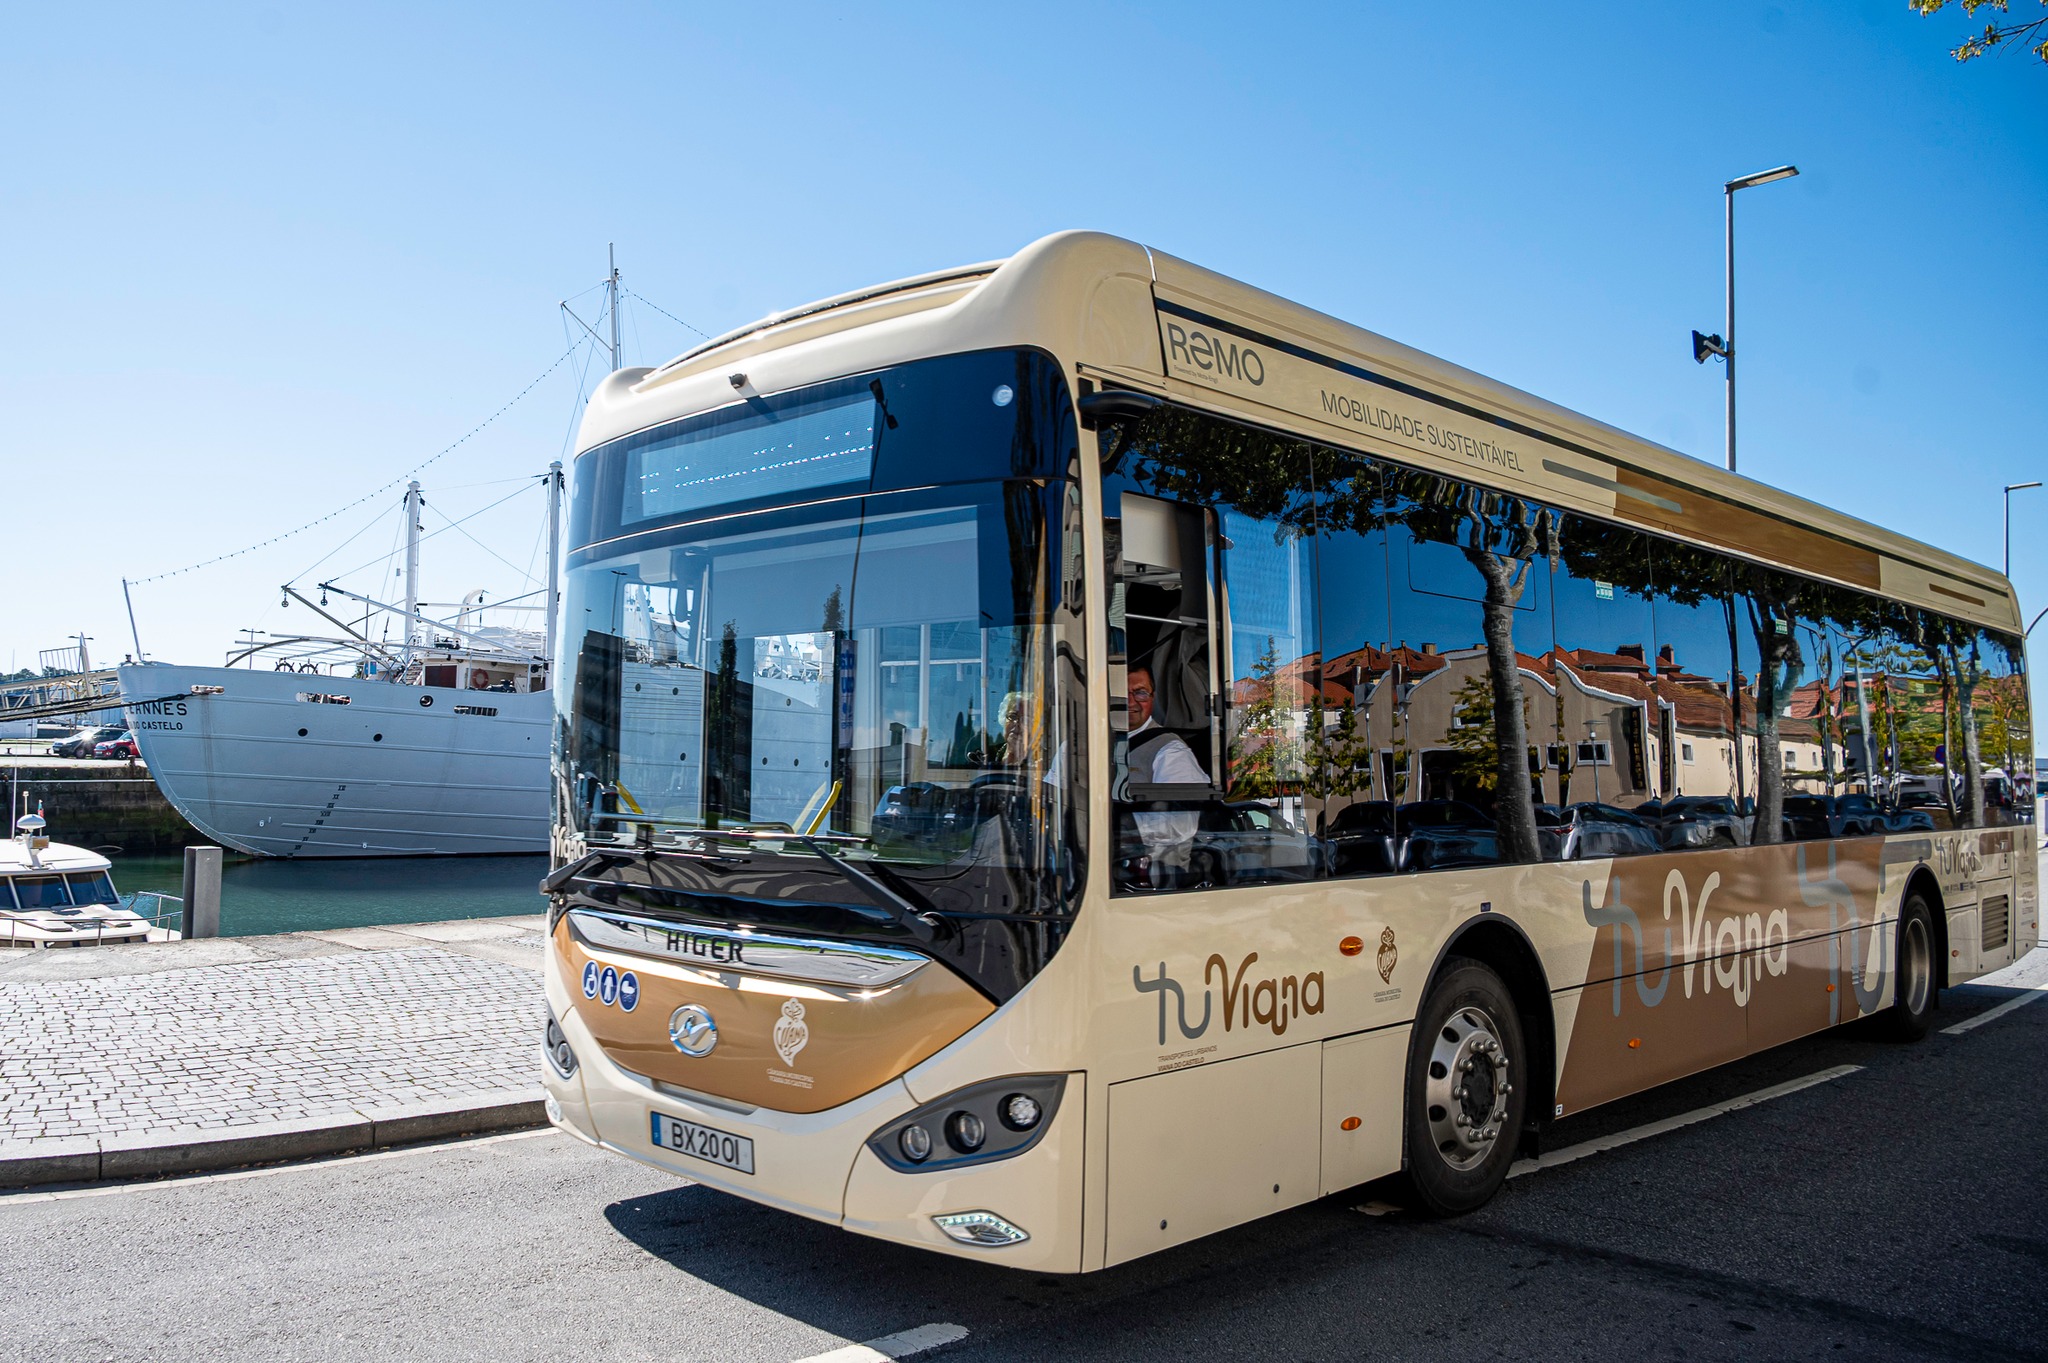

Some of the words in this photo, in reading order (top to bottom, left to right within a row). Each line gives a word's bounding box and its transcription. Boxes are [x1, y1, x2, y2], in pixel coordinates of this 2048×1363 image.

[1321, 390, 1425, 442] MOBILIDADE
[1427, 424, 1525, 473] SUSTENTÁVEL
[141, 721, 183, 731] CASTELO
[667, 930, 743, 962] HIGER
